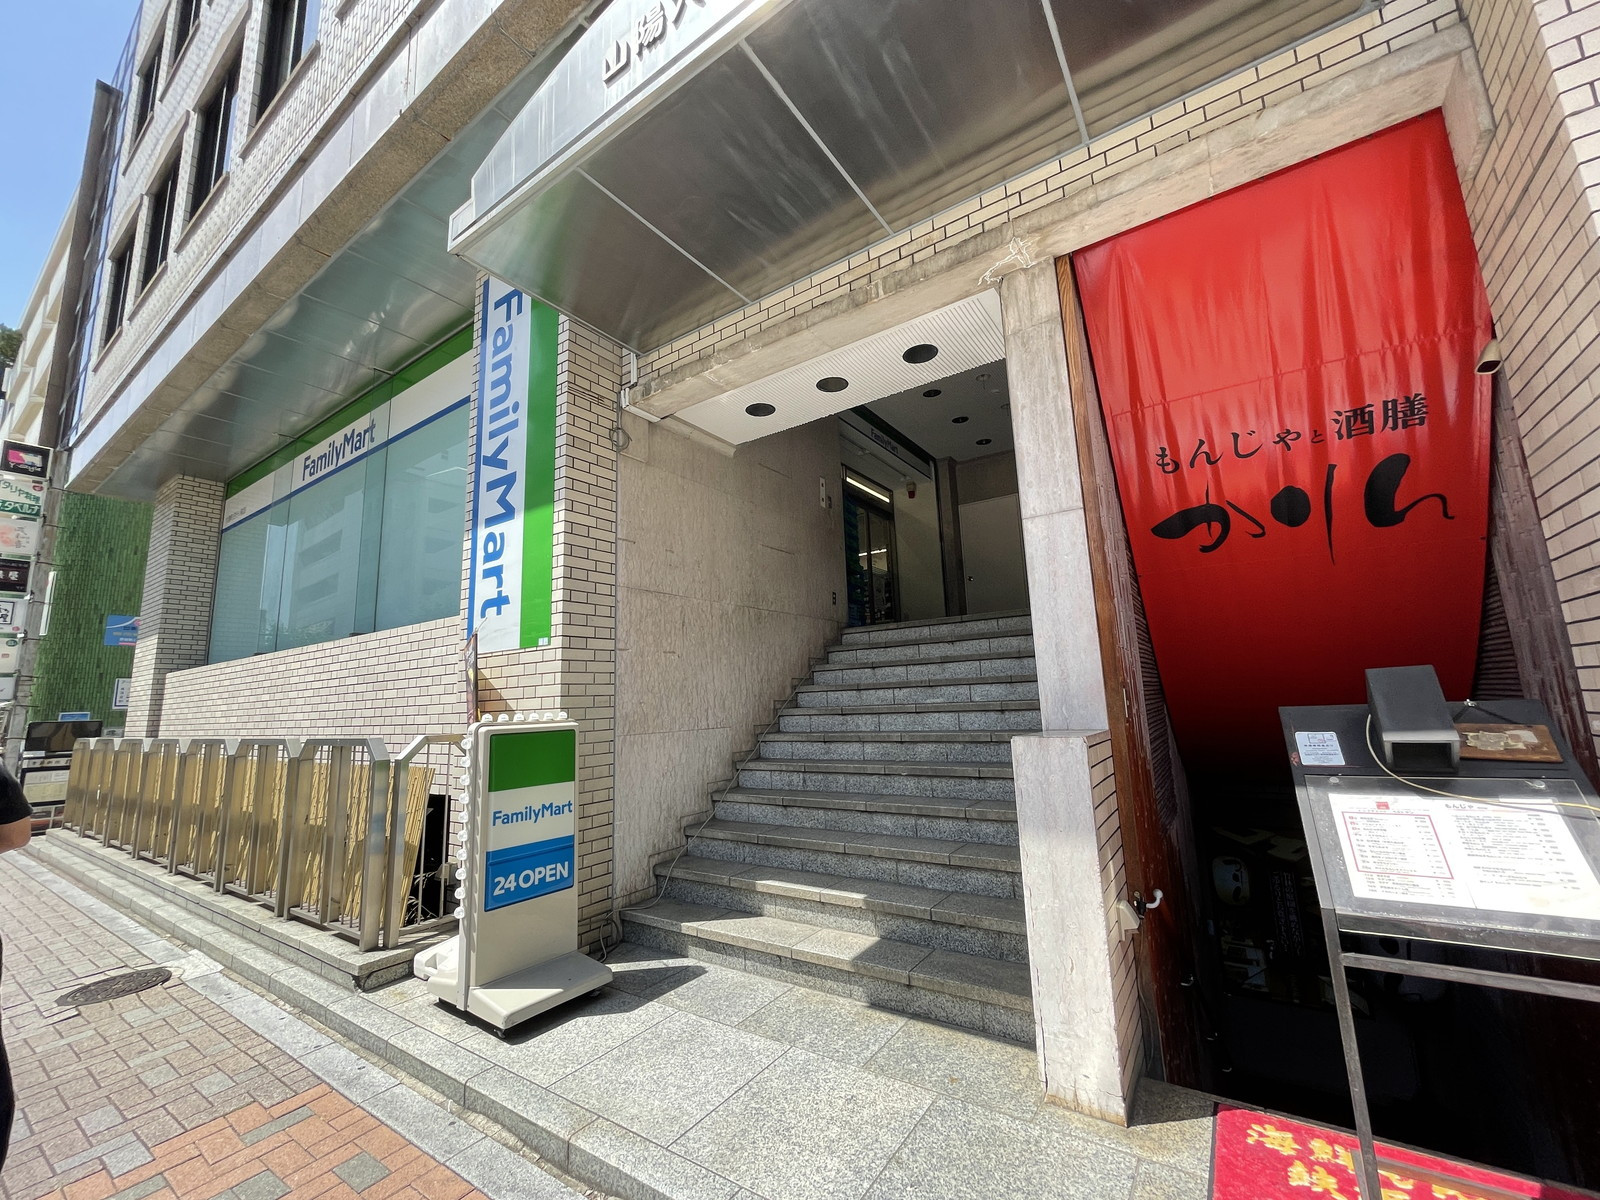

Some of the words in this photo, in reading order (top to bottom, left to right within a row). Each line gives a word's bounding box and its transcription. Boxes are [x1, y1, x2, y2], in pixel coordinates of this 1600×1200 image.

[302, 417, 376, 481] FamilyMart
[480, 289, 523, 619] FamilyMart
[492, 800, 573, 827] FamilyMart
[493, 873, 517, 897] 24
[518, 861, 569, 890] OPEN
